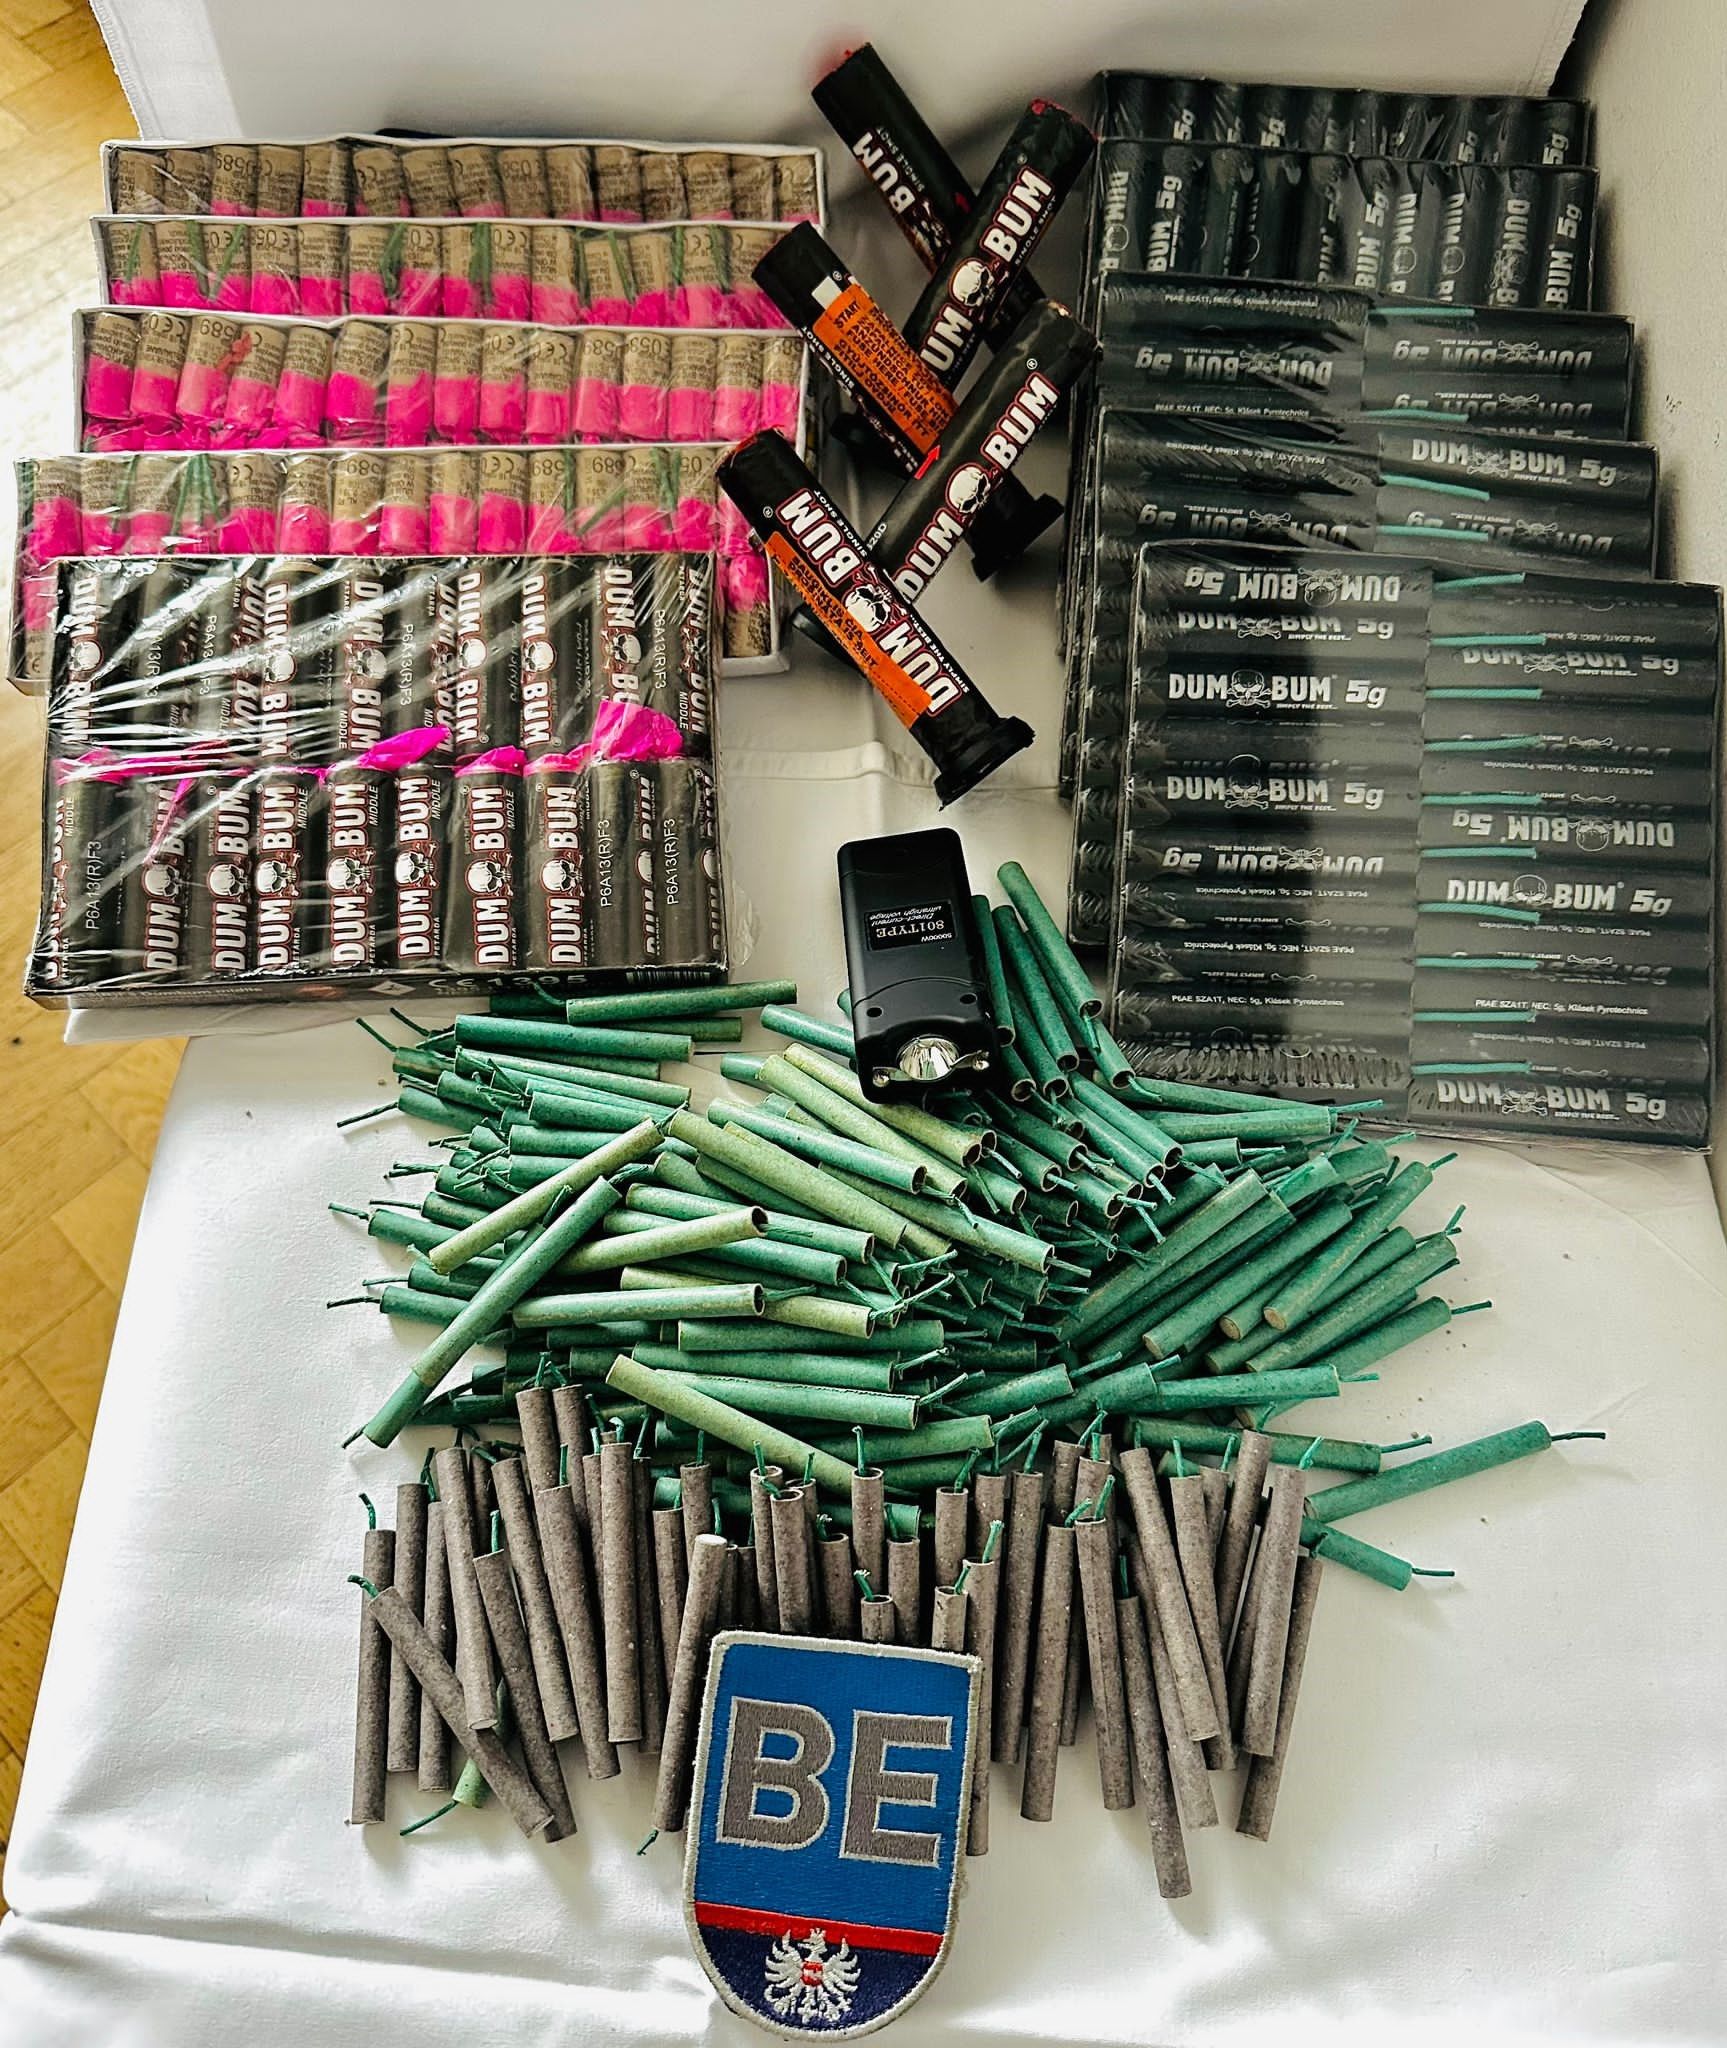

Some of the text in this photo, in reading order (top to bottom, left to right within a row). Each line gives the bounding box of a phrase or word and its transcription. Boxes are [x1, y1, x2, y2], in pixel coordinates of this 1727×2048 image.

[1261, 118, 1286, 147] 5g
[1543, 133, 1568, 164] 5g
[853, 132, 915, 215] BUM
[984, 169, 1052, 262] BUM
[1148, 176, 1182, 272] BUM 5g
[1356, 191, 1389, 288] BUM 5g
[1502, 200, 1530, 253] DUM
[1545, 204, 1582, 304] BUM 5g
[830, 300, 863, 330] START
[920, 306, 973, 371] UM
[800, 324, 855, 390] SINGLE SHOT
[845, 328, 873, 357] FUSE
[871, 356, 899, 385] HERE
[985, 375, 1059, 470] BUM
[1412, 439, 1616, 487] DUM BUM 5g
[780, 491, 861, 585] BUM
[811, 487, 868, 557] SINGLE SHOT
[896, 512, 964, 600] DUM
[1184, 568, 1399, 602] DUM BUM 5g
[266, 583, 288, 651] DUM
[605, 568, 635, 629] DUM
[1178, 612, 1394, 639] DUM BUM 5g
[400, 623, 414, 705] P6A13(R)F3
[456, 573, 481, 743] DUM BUM
[522, 576, 548, 745] DUM BUM
[653, 609, 667, 689] P6A13(R)F3
[879, 624, 959, 713] DUM
[928, 642, 946, 662] THE
[942, 661, 970, 693] SIMPLY
[351, 689, 383, 750] BUM
[679, 692, 689, 729] MIDDLE
[1169, 674, 1387, 709] DUM BUM 5g
[339, 710, 348, 749] MIDDLE
[65, 797, 74, 837] MIDDLE
[298, 788, 309, 830] MIDDLE
[369, 785, 378, 826] MIDDLE
[432, 779, 441, 819] MIDDLE
[1168, 776, 1384, 810] DUM BUM 5g
[1453, 810, 1674, 846] DUM BUM 5g
[86, 841, 102, 929] P6A13(R)F3
[214, 790, 250, 970] DUM BUM
[259, 786, 296, 965] DUM BUM
[334, 783, 366, 962] DUM BUM
[400, 777, 430, 955] DUM BUM
[471, 787, 508, 963] DUM BUM
[547, 787, 581, 964] DUM BUM
[600, 819, 613, 906] P6A13(R)F3
[665, 819, 679, 905] P6A13(R)F3
[1196, 887, 1246, 896] Pyrotechnics
[876, 920, 944, 938] 801TYPE
[1447, 879, 1672, 916] DUM BUM 5g
[147, 902, 181, 971] DUM
[1184, 942, 1234, 950] Pyrotechnics
[1597, 1005, 1648, 1016] Pyrotechnics
[1437, 1080, 1666, 1120] DUM BUM 5g
[716, 1696, 953, 1868] BE
